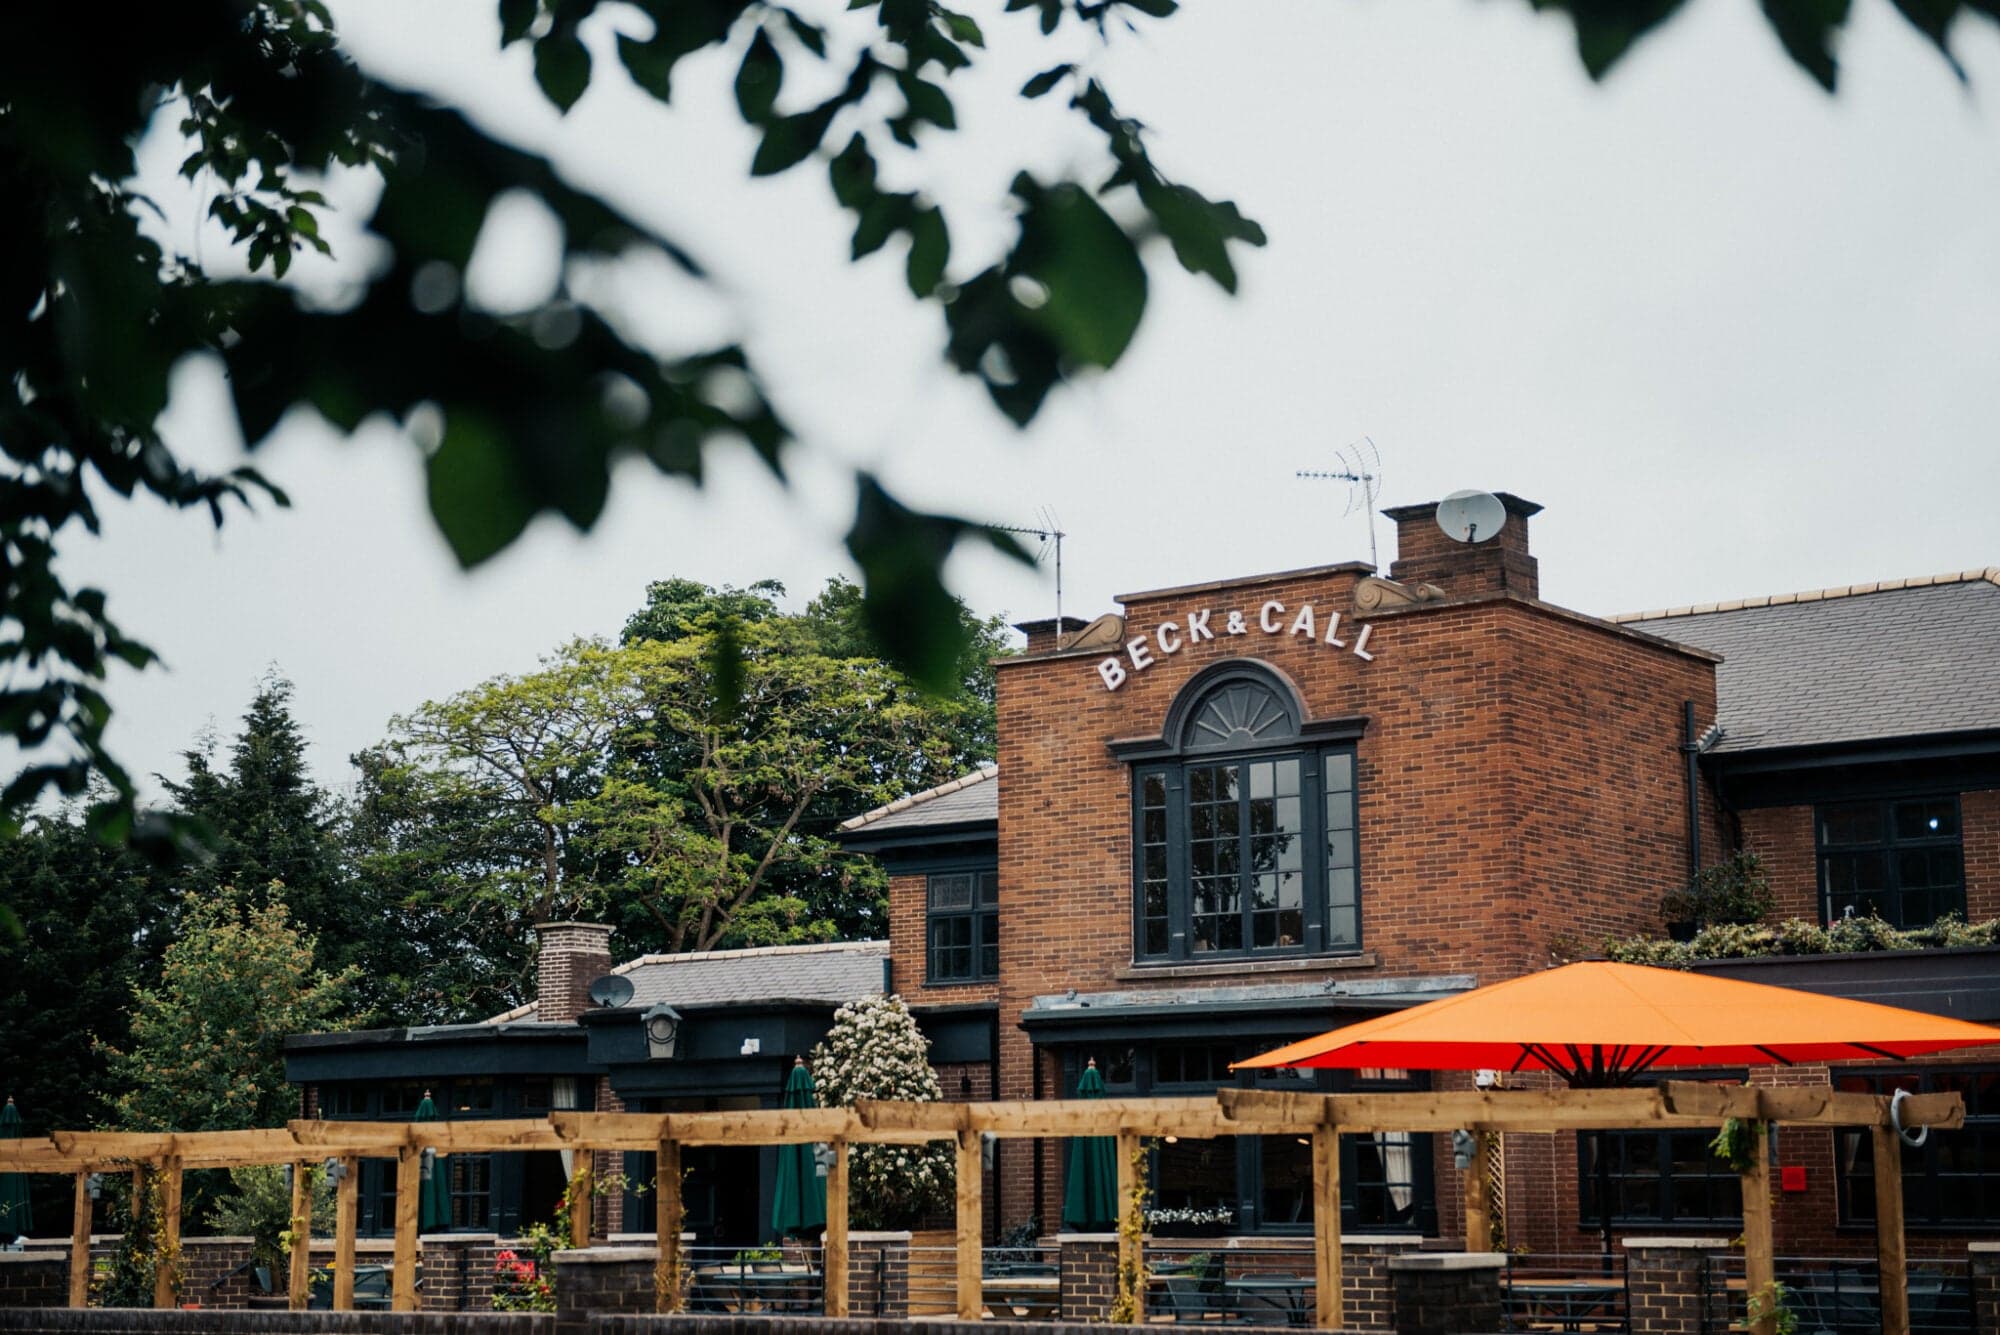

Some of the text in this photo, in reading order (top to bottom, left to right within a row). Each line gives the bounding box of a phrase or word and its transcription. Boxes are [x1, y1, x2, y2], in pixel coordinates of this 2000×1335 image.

[1098, 600, 1374, 691] BECK & CALL
